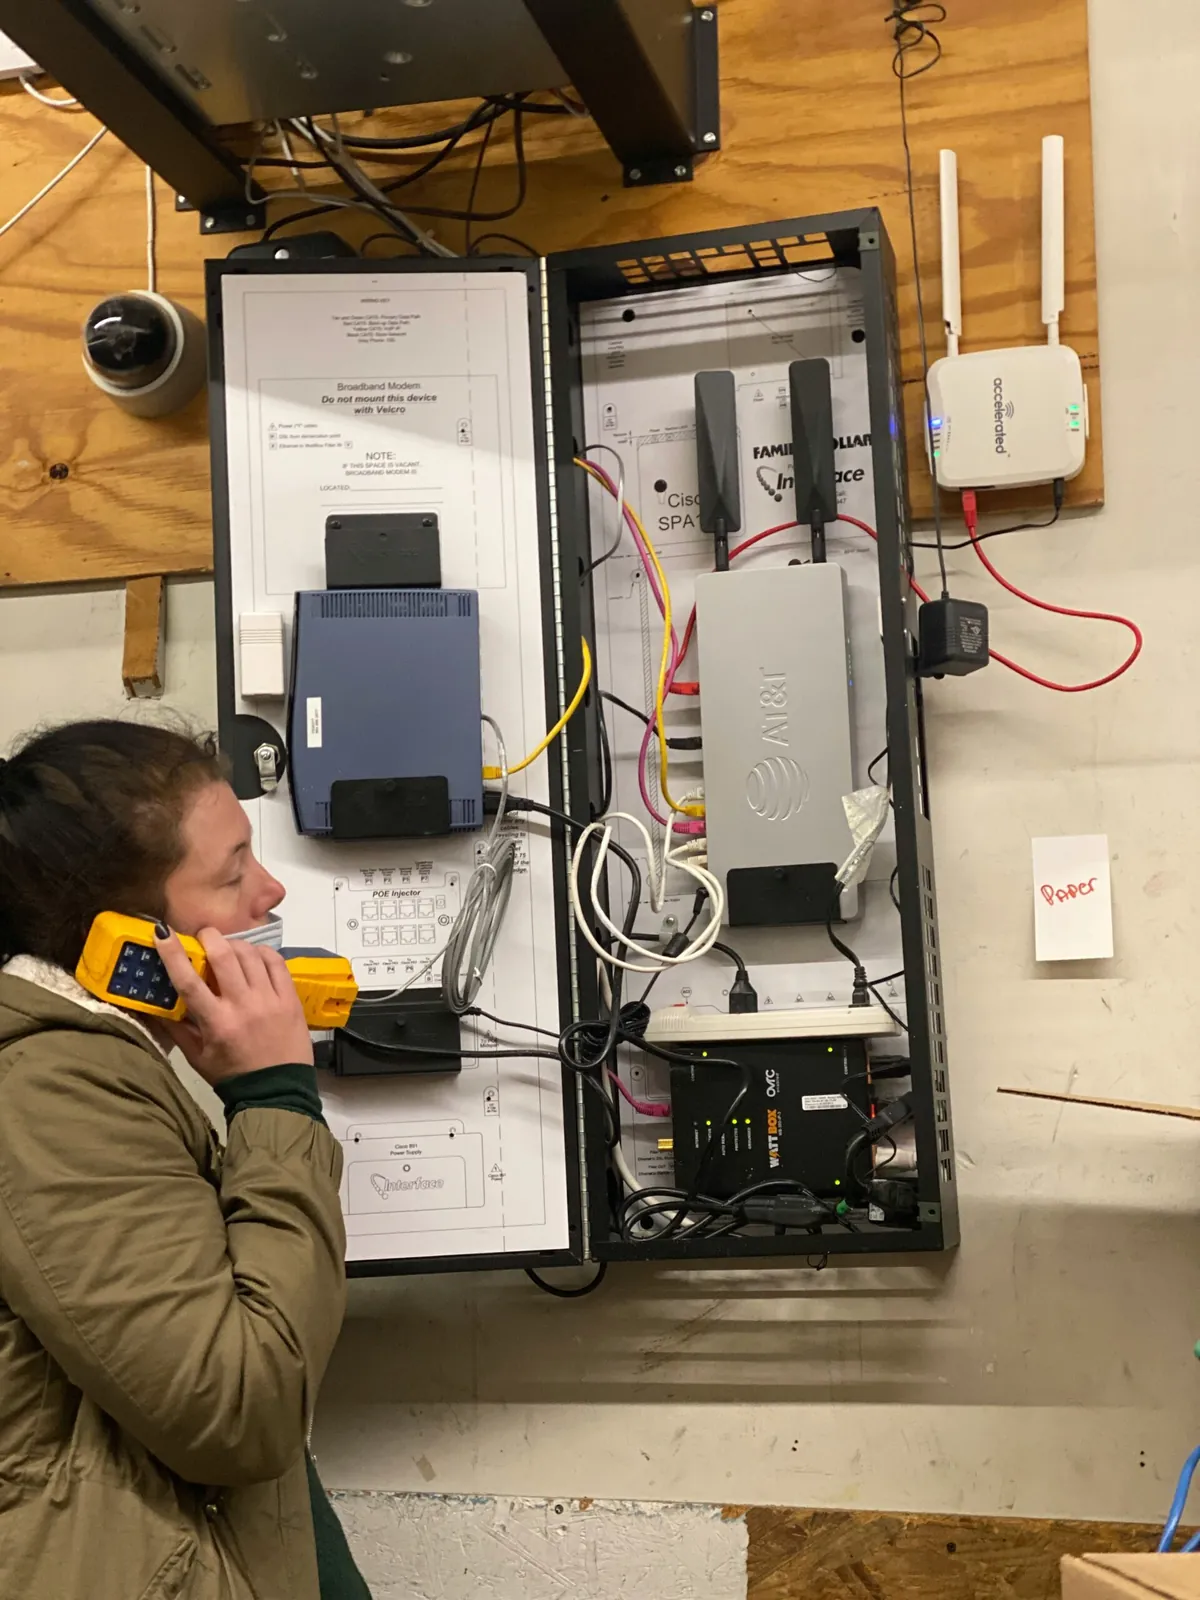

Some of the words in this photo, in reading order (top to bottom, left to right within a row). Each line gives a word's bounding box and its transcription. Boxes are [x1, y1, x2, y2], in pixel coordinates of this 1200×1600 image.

[337, 382, 386, 391] Broadband
[388, 382, 421, 390] Modem
[387, 394, 404, 402] this
[406, 394, 437, 402] device
[376, 406, 406, 414] Velcro
[994, 378, 1007, 454] accelerated
[366, 452, 396, 460] NOTE:
[668, 492, 700, 508] Cisc
[759, 667, 790, 746] AT&T
[392, 890, 421, 898] Injector
[384, 1176, 444, 1192] Interface
